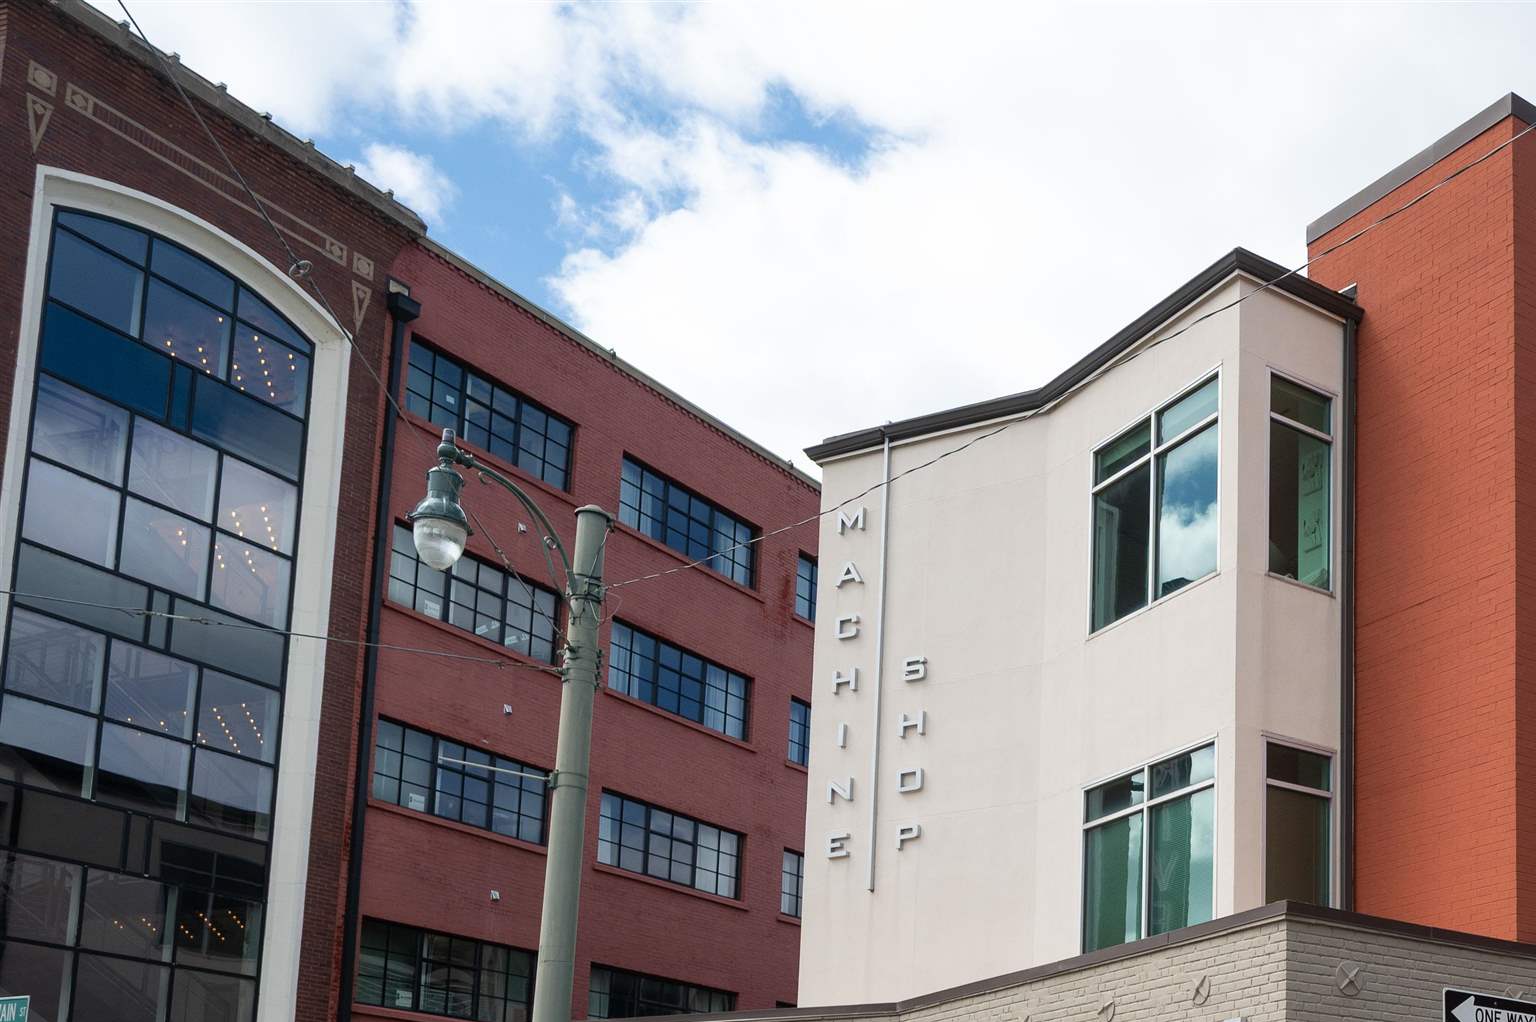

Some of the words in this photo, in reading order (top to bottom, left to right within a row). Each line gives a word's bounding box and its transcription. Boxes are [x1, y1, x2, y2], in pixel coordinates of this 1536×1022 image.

[826, 506, 867, 860] MACHINE
[896, 656, 928, 851] SHOP
[19, 1006, 27, 1017] ST
